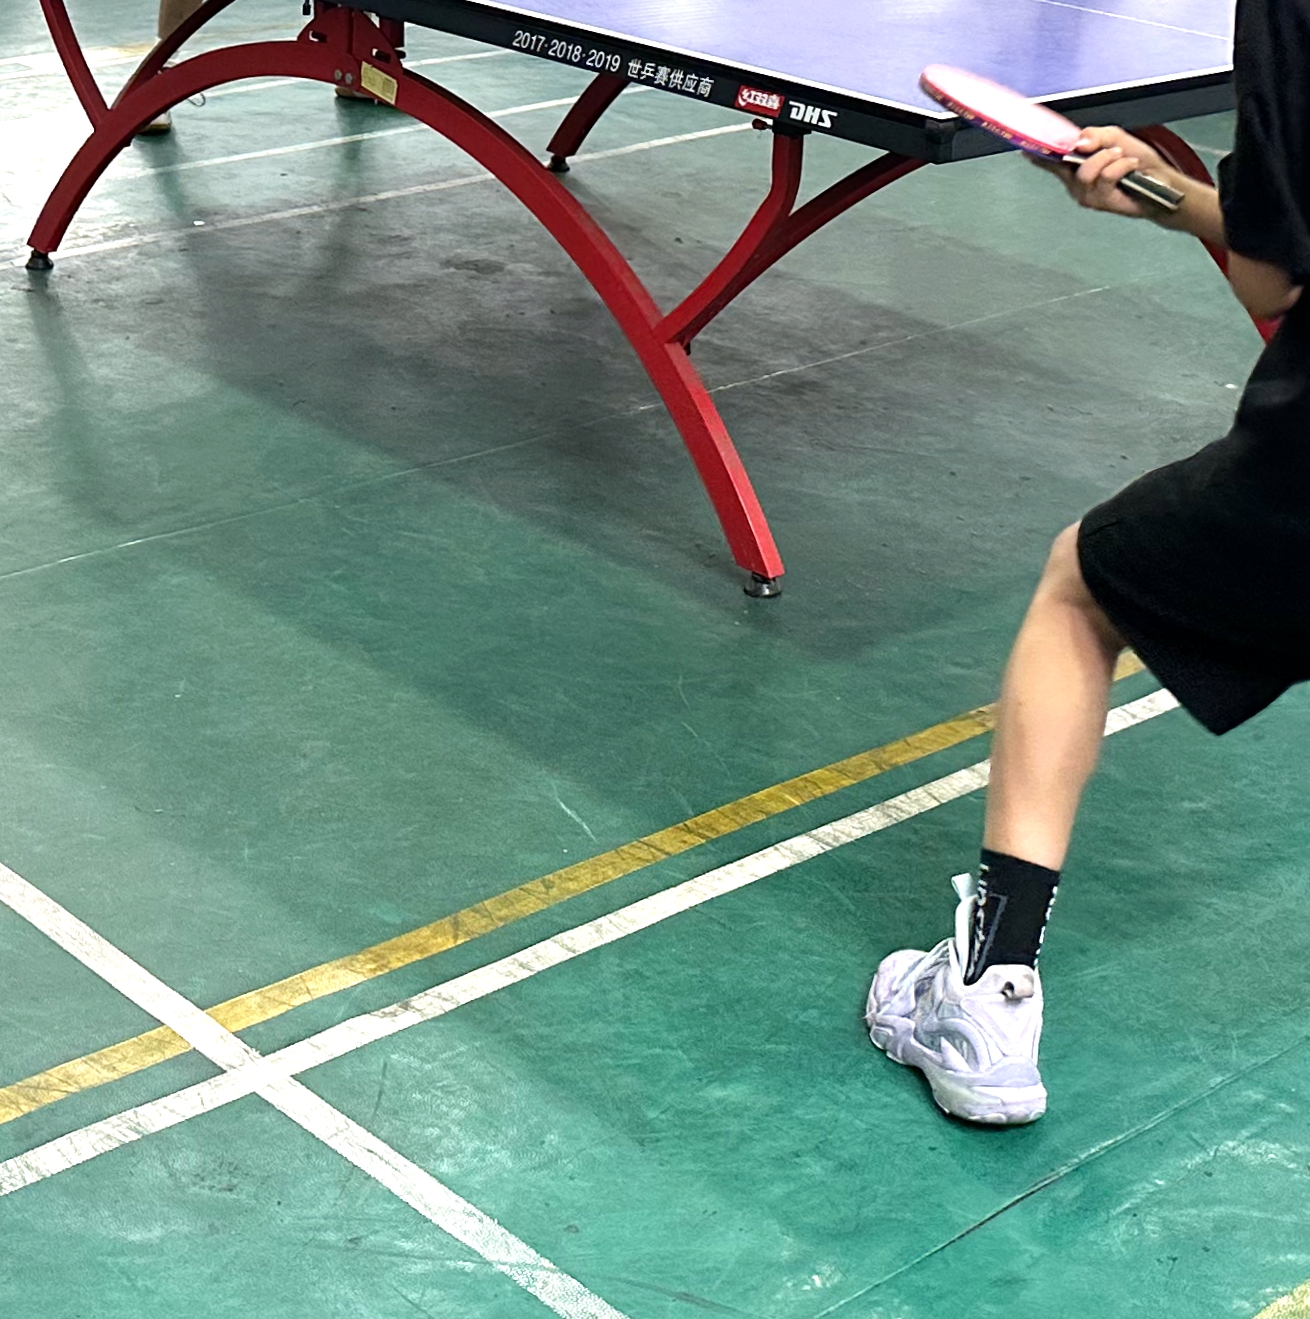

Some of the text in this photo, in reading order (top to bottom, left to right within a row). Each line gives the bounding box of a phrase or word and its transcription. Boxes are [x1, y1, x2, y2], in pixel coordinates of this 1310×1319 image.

[628, 58, 714, 98] 世乒赛供应商
[789, 100, 838, 128] DHS
